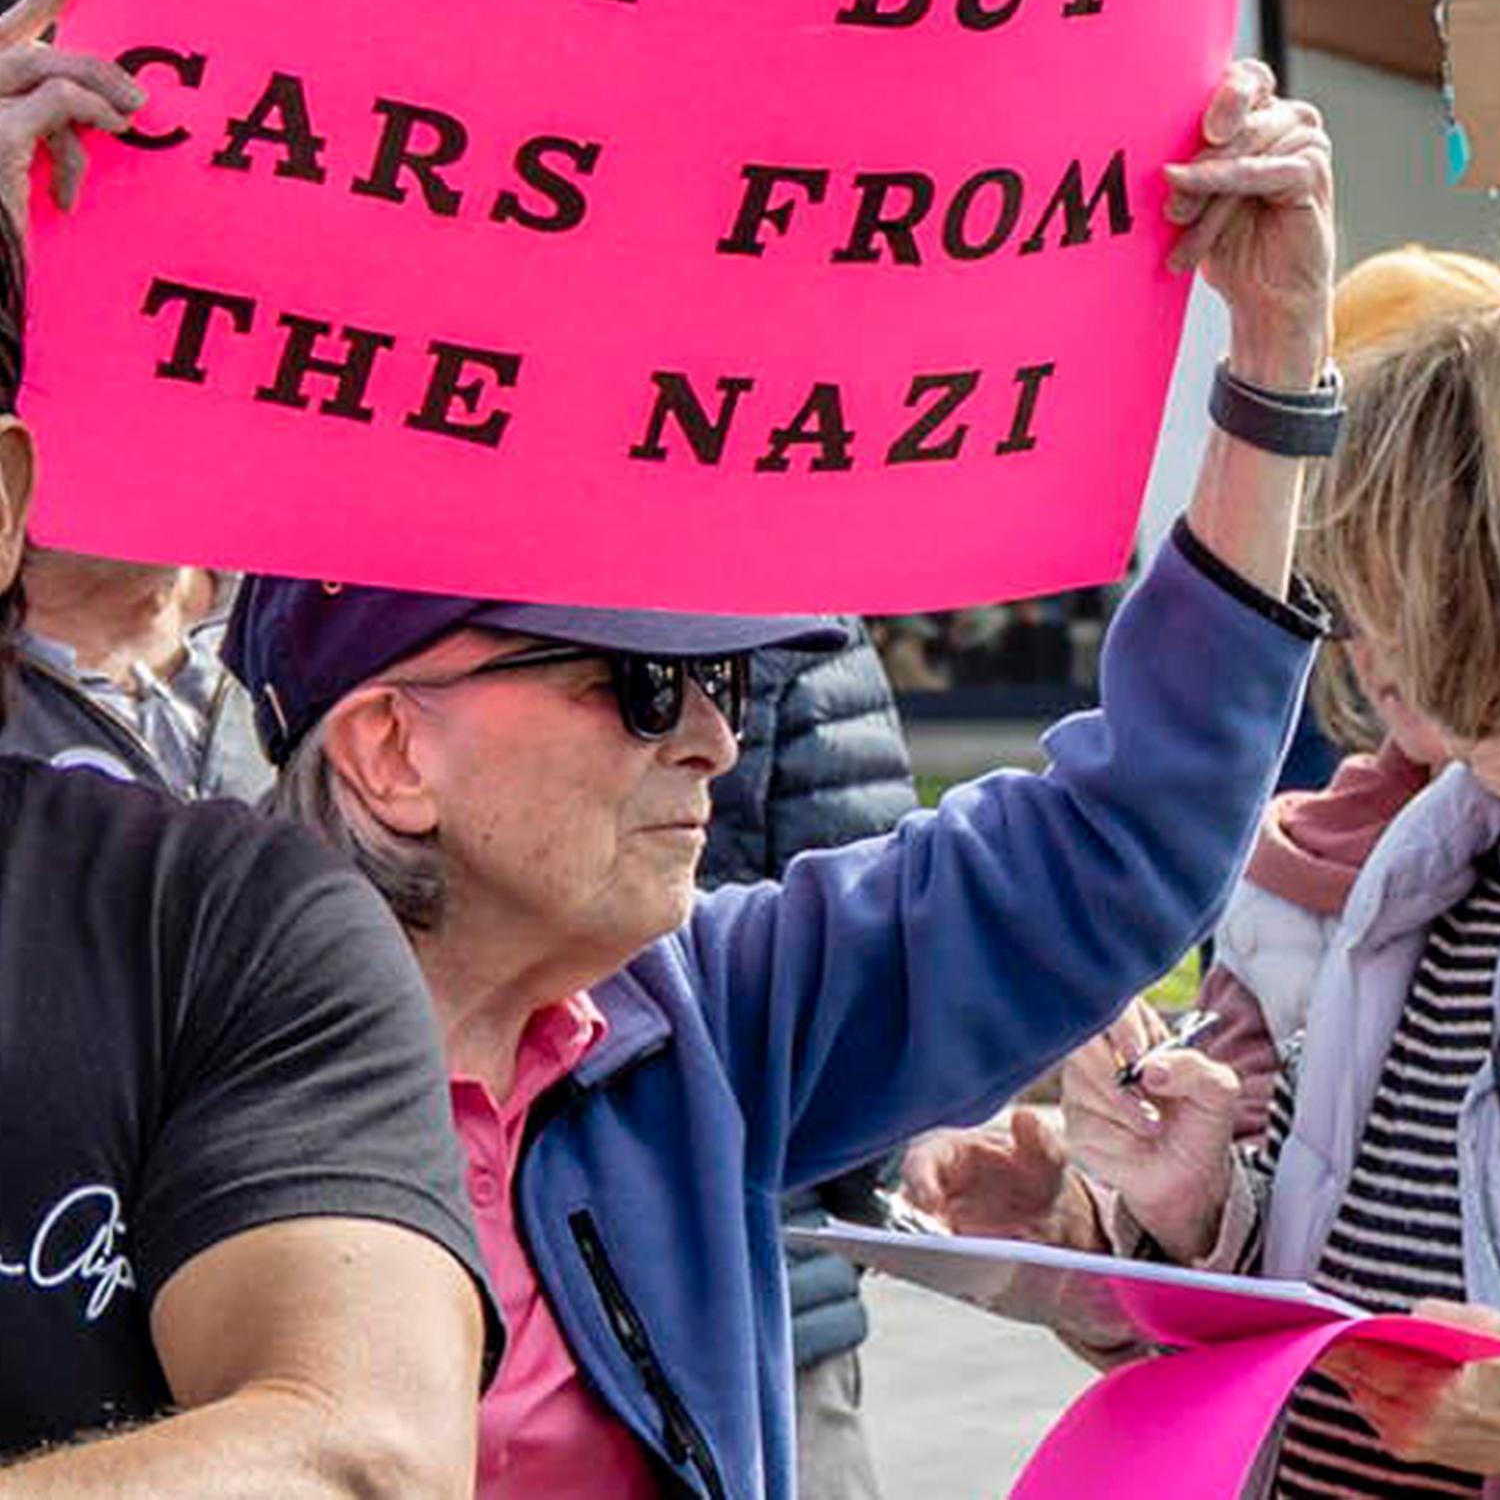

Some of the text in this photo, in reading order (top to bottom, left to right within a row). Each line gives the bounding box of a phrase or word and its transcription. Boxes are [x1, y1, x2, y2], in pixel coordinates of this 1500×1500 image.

[112, 46, 1135, 267] CARS FROM
[141, 276, 1055, 472] THE NAZI
